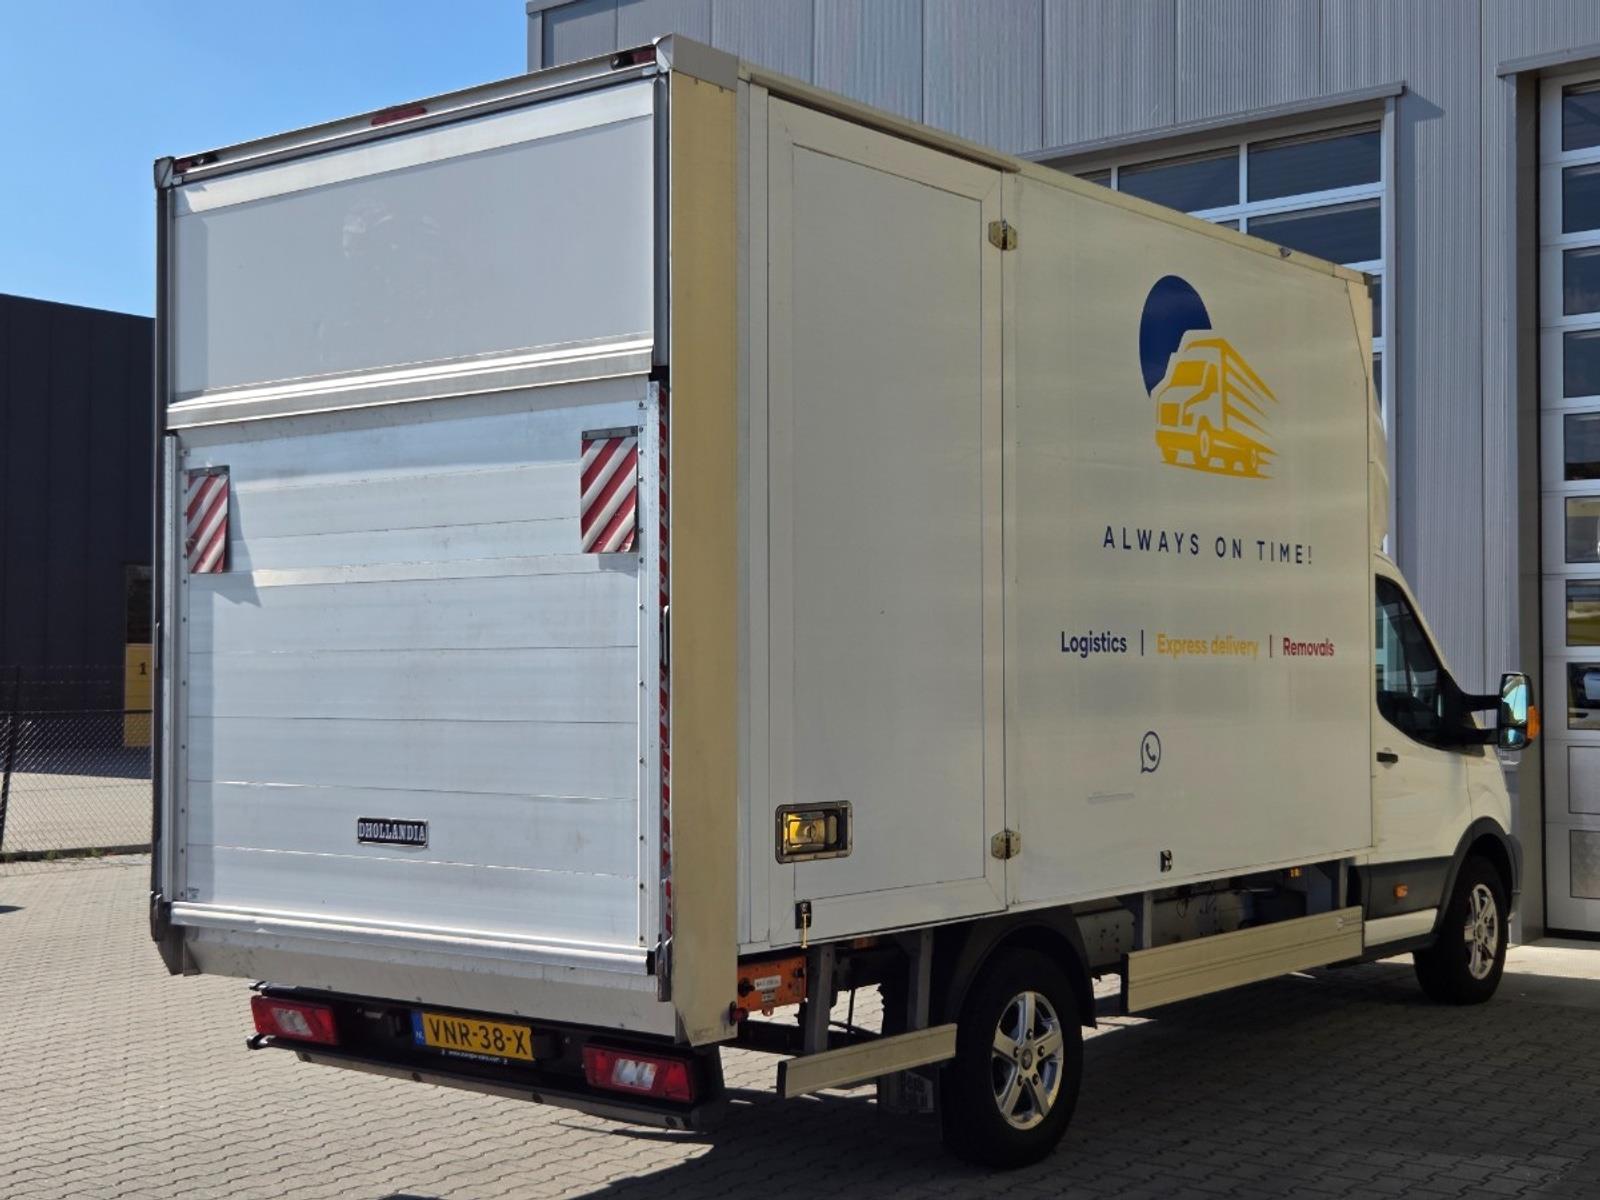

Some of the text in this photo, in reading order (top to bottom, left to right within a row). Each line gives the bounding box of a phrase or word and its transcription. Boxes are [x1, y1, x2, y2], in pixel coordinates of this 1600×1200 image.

[1103, 525, 1312, 565] ALWAYS ON TIME!
[1061, 630, 1335, 661] Logistics Express delivery Removals
[139, 661, 147, 675] 1
[358, 822, 426, 842] DHOLLANDIA
[428, 1017, 528, 1056] VNR-38-X
